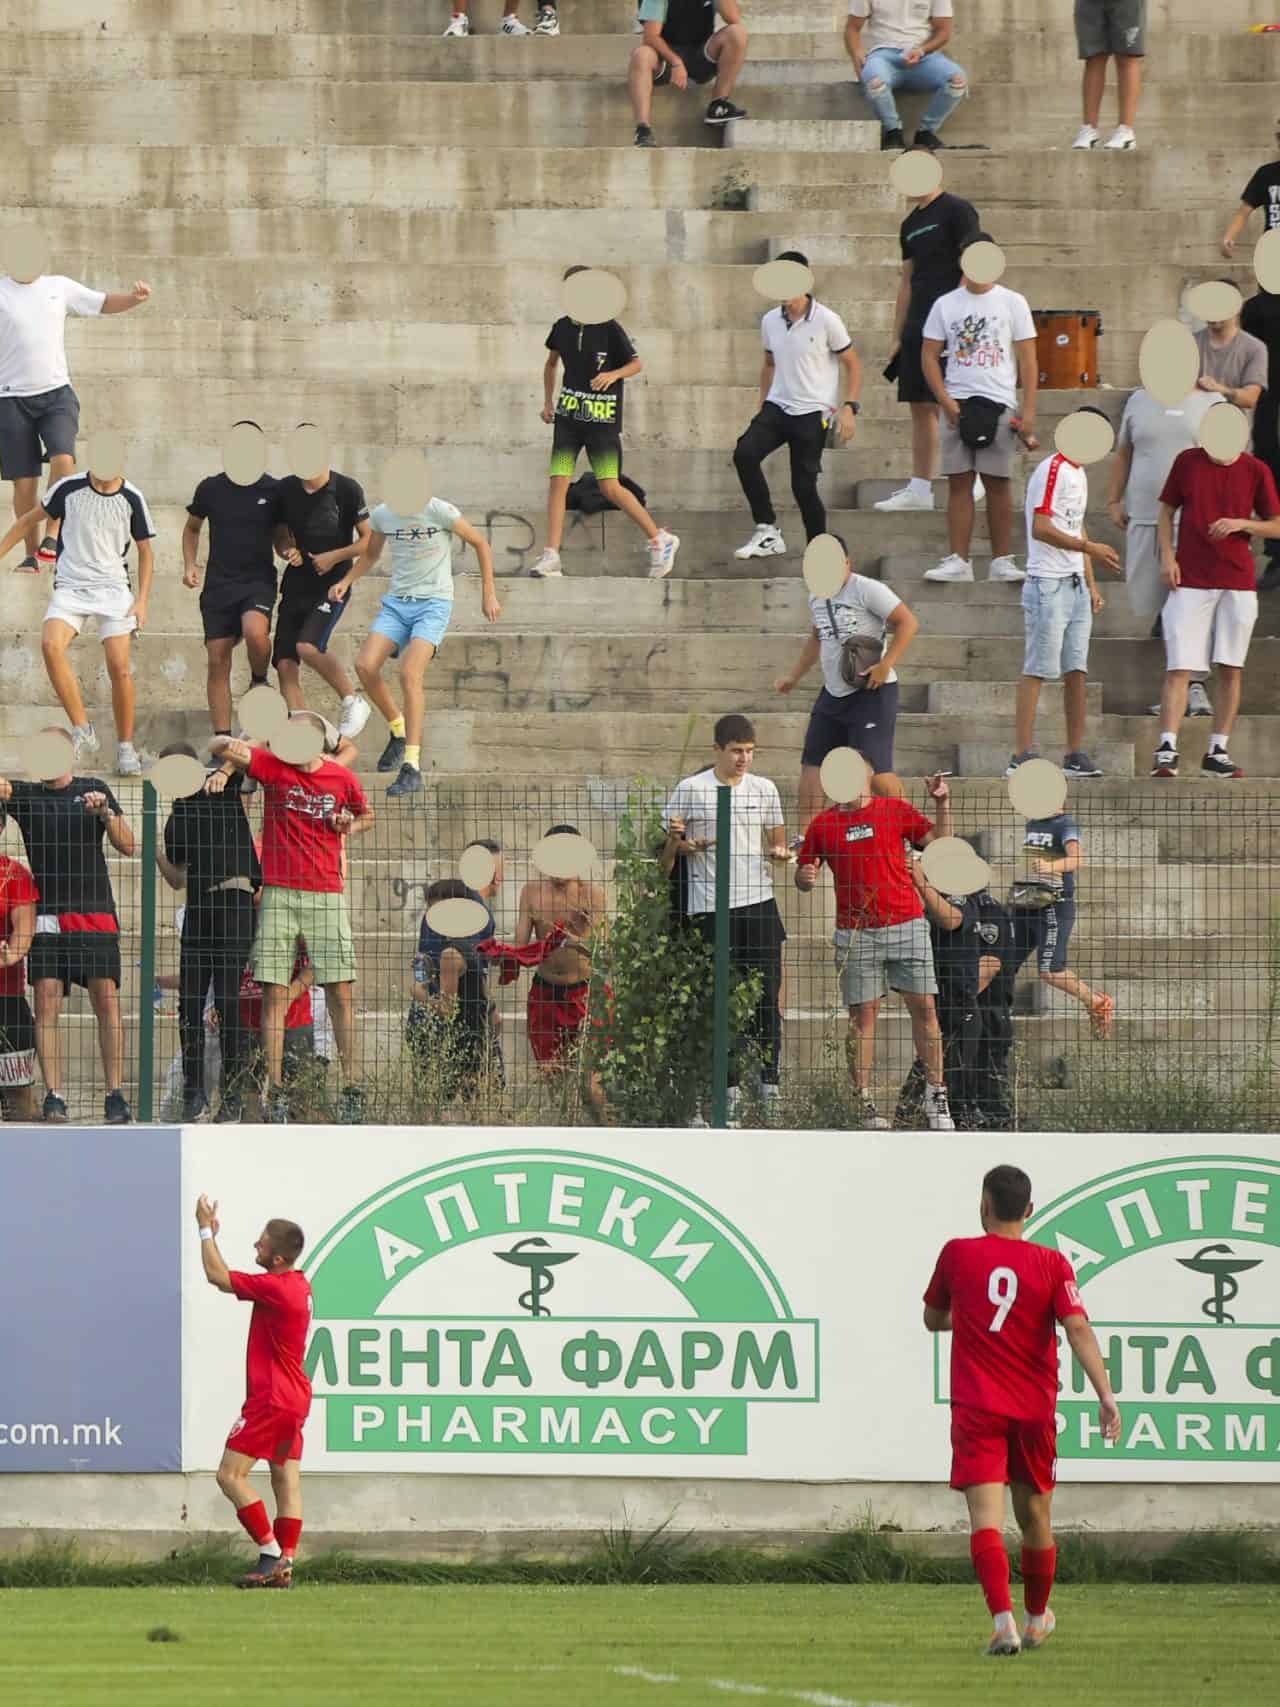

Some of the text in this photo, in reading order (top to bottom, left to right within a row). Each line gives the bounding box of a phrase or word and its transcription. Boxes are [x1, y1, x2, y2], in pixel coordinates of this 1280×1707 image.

[395, 527, 439, 541] EXP
[373, 1173, 715, 1284] АПТЕКИ
[987, 1266, 1018, 1332] 9
[561, 1329, 799, 1391] ФАРМ
[352, 1404, 724, 1445] PHARMACY
